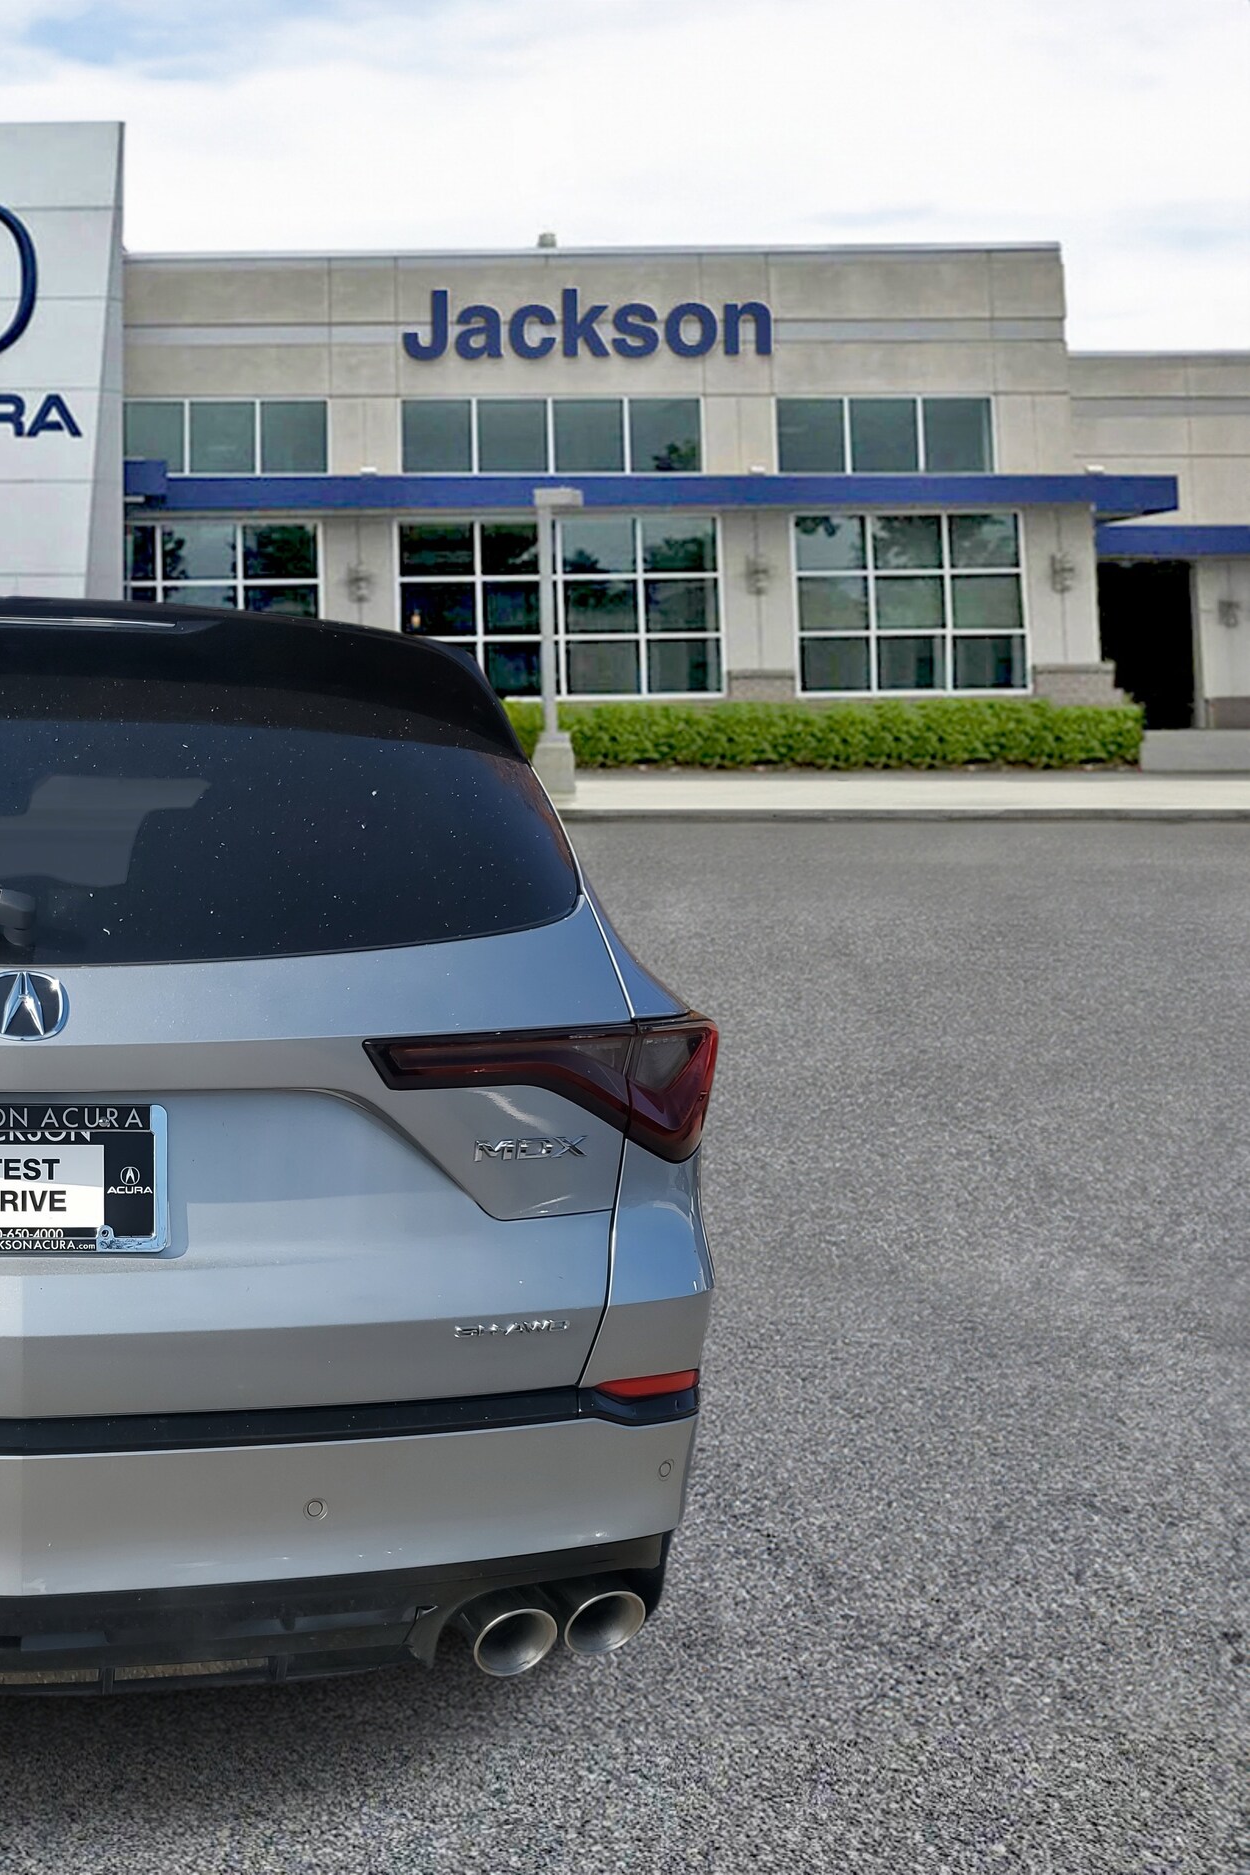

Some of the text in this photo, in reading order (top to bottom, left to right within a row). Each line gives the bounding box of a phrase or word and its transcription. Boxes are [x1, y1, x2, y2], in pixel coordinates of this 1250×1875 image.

[403, 288, 772, 360] Jackson
[40, 1107, 143, 1128] ACURA
[473, 1135, 589, 1162] MDX
[107, 1186, 153, 1194] ACURA
